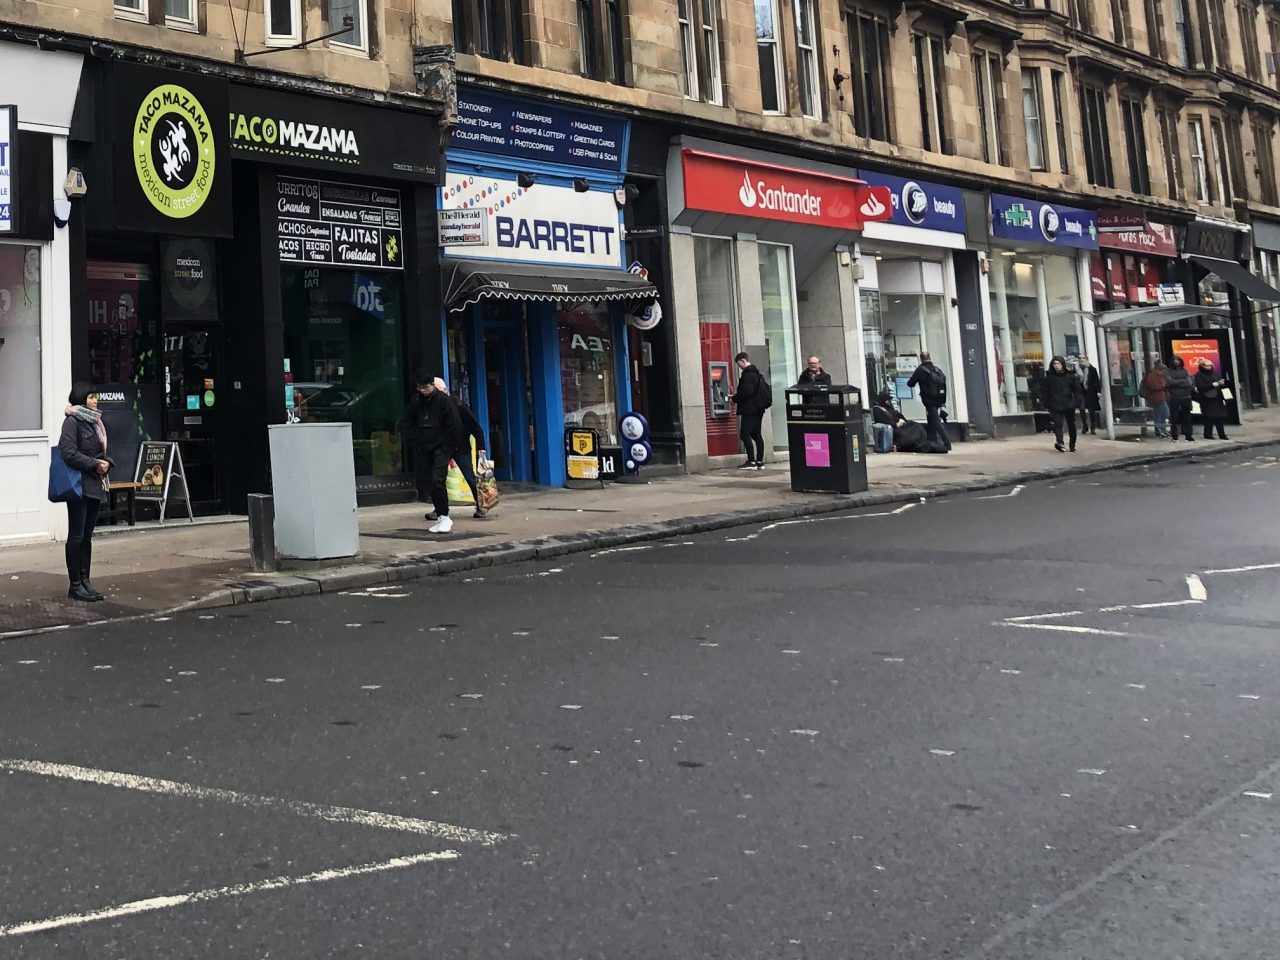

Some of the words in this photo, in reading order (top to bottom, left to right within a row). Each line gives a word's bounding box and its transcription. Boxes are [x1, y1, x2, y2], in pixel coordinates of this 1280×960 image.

[457, 101, 493, 114] STATIONERY
[138, 97, 161, 135] TACO
[162, 92, 208, 144] MAZAMA
[457, 115, 477, 126] PHONE
[477, 118, 502, 130] TOP-UPS
[516, 111, 552, 124] NEWSPAPERS
[515, 124, 537, 135] STAMPS
[542, 129, 566, 140] LOTTERY
[574, 120, 603, 133] MAGAZINES
[279, 120, 360, 156] MAZAMA
[456, 130, 480, 140] COLOUR
[480, 133, 505, 145] PRINTING
[514, 138, 555, 152] PHOTOCOPYING
[573, 134, 598, 146] GREETING
[598, 138, 615, 148] CARDS
[572, 147, 585, 156] USB
[584, 150, 600, 159] PRINT
[599, 152, 604, 160] &
[603, 152, 618, 162] SCAN
[139, 153, 171, 208] mexican
[172, 189, 200, 210] street
[197, 159, 210, 192] food
[277, 182, 318, 199] URRITOS
[757, 181, 821, 216] Santander
[891, 193, 899, 210] cy
[322, 208, 357, 220] ENSALADAS
[933, 196, 955, 218] beauty
[440, 212, 452, 220] The
[457, 211, 480, 219] Herald
[278, 222, 306, 235] ACHOS
[334, 227, 378, 245] FAJITAS
[495, 216, 615, 255] BARRETT
[279, 240, 299, 251] ACOS
[338, 244, 376, 262] Tostadas
[191, 268, 204, 278] food
[99, 392, 125, 400] MAZAMA
[146, 453, 165, 461] LUNCH
[601, 456, 615, 473] ld
